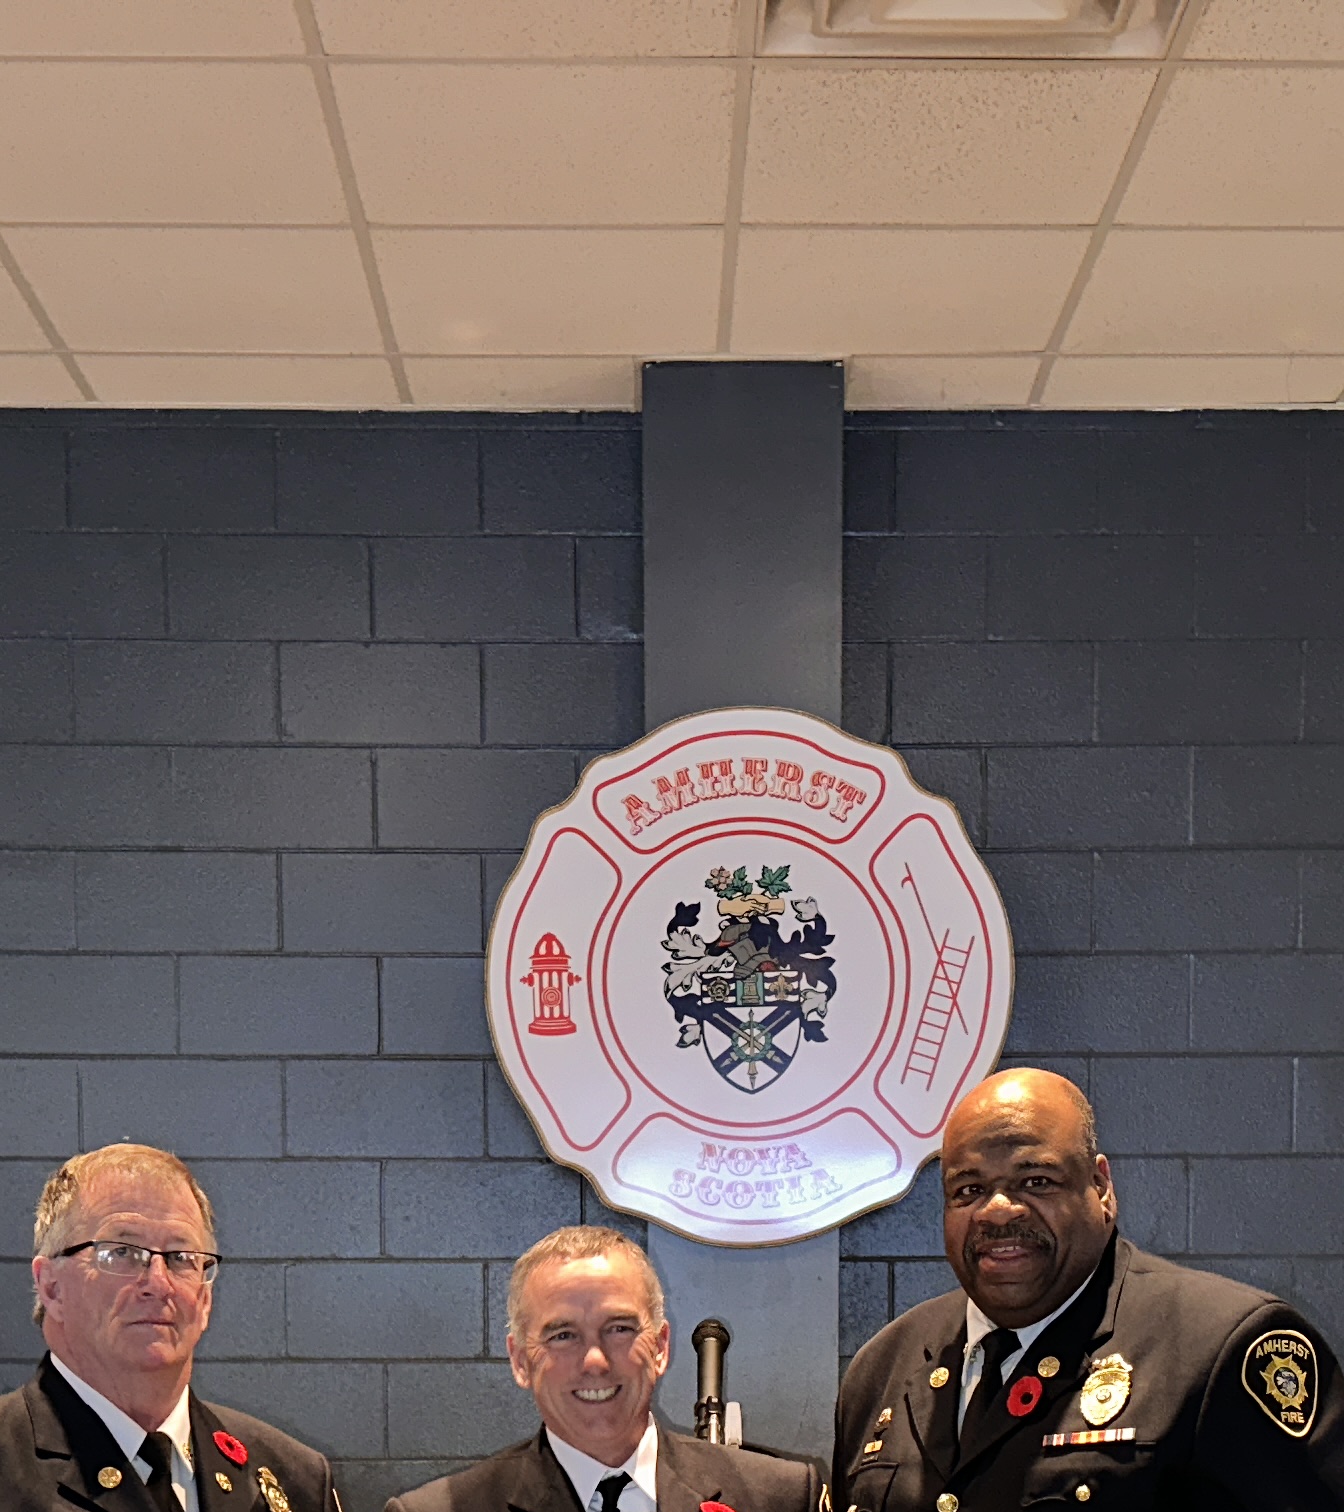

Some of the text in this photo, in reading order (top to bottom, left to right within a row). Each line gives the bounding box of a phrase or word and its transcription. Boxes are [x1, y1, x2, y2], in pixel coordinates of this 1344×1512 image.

[621, 757, 867, 835] AMHERST
[696, 1141, 812, 1176] NOVA
[668, 1168, 843, 1209] SCOTIA
[1256, 1339, 1310, 1360] AMHERST
[1280, 1411, 1305, 1424] FIRE
